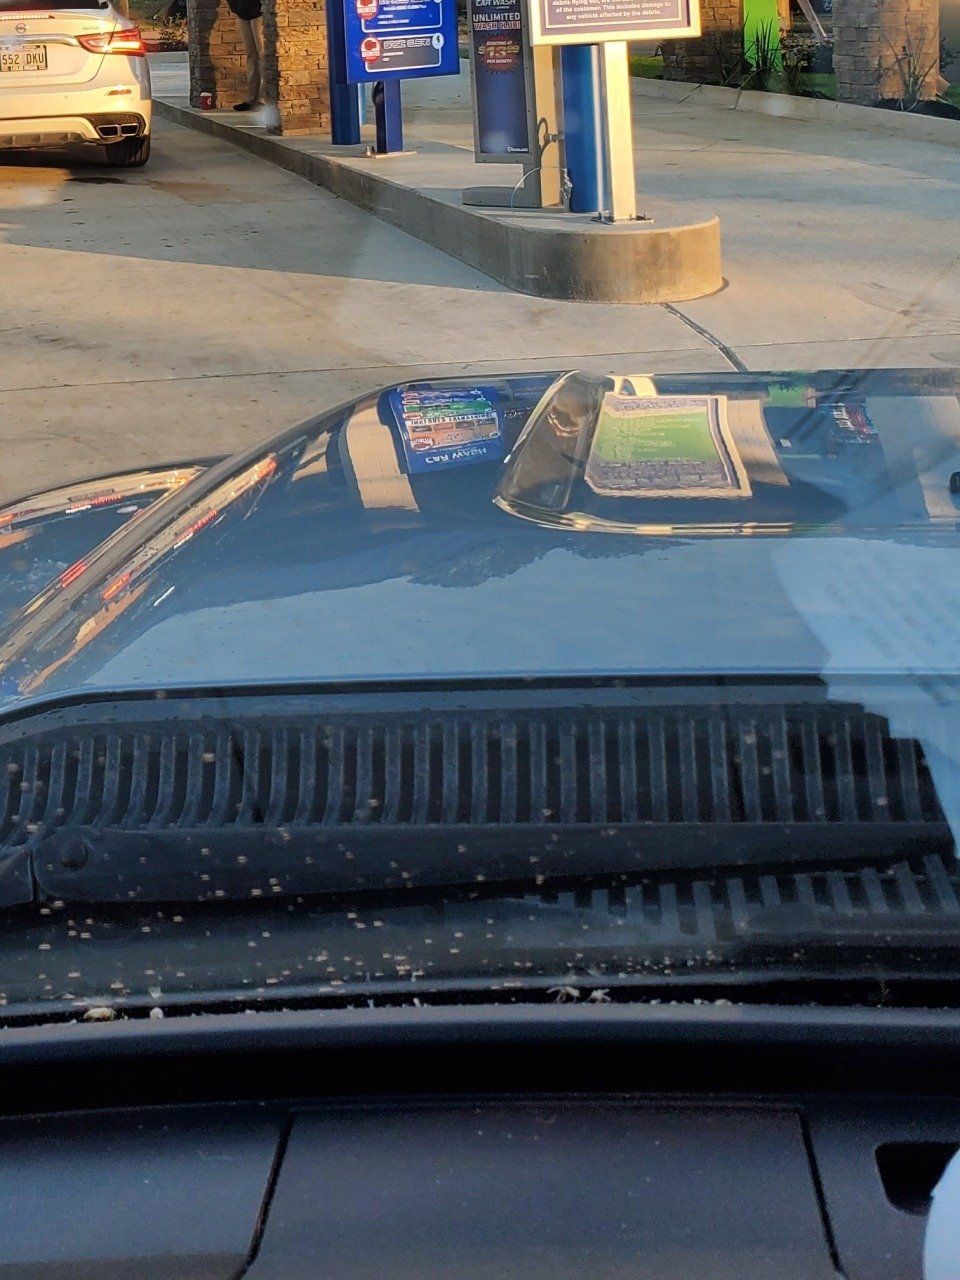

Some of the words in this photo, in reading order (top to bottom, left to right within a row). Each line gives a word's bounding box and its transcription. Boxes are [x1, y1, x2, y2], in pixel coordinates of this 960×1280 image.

[476, 0, 491, 7] CAR
[616, 2, 641, 10] includes
[472, 12, 520, 22] UNLIMITED
[473, 22, 498, 31] WASH
[498, 21, 521, 30] CLUB!
[2, 53, 20, 65] 552
[26, 52, 45, 64] DKU
